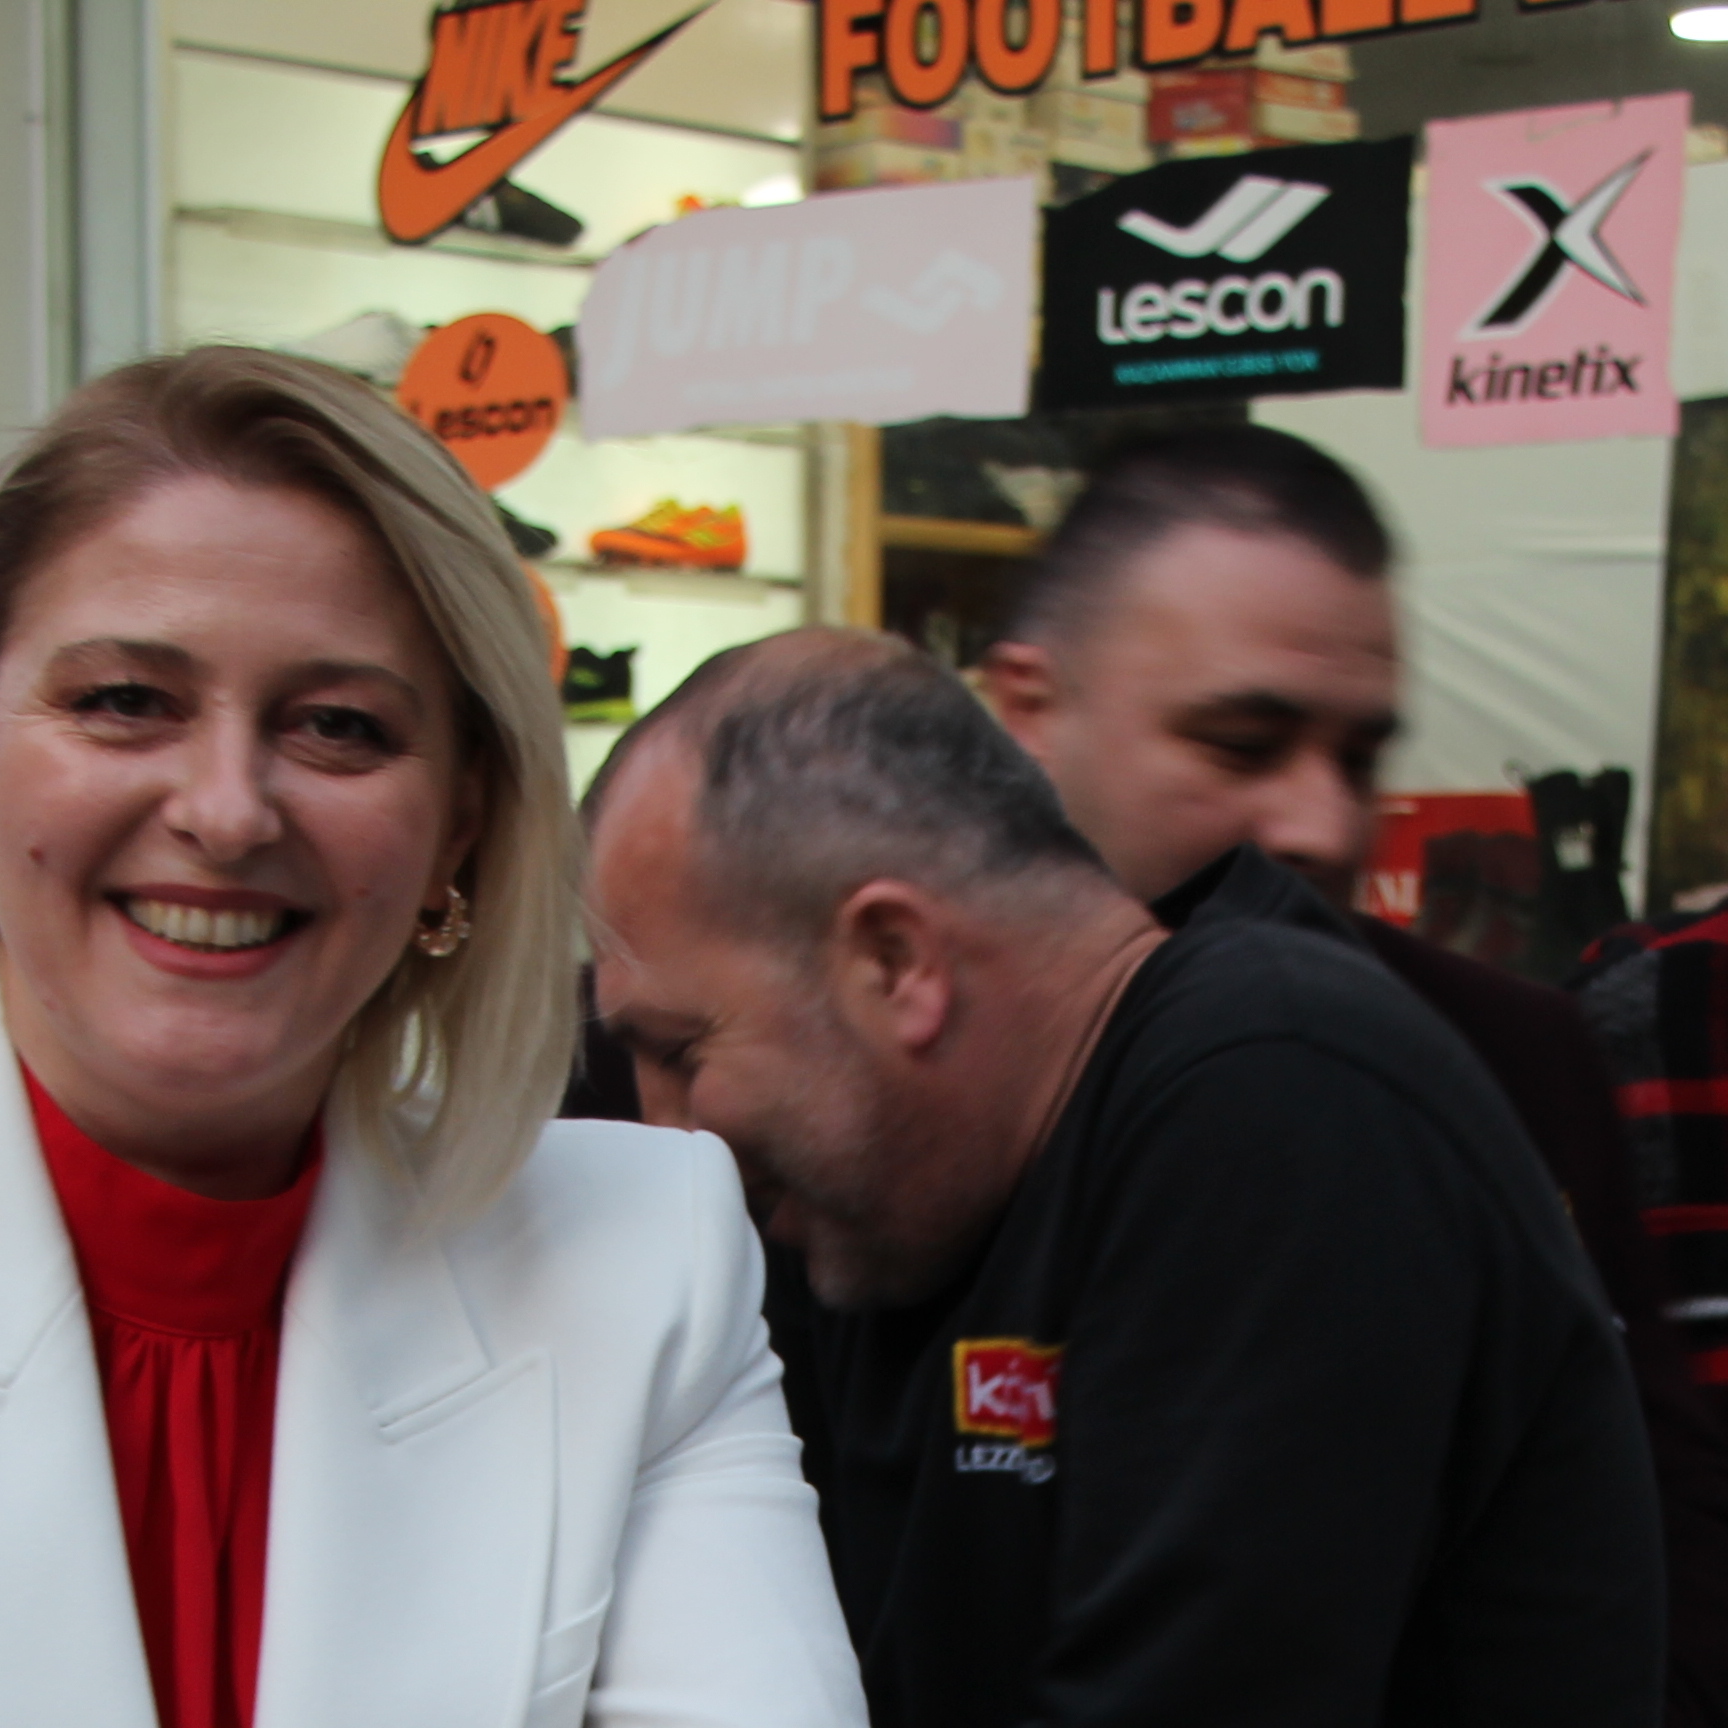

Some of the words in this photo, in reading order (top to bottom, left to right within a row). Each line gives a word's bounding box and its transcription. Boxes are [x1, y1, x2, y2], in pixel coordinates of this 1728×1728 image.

[818, 0, 1478, 121] FOOTB
[600, 236, 857, 392] JUMP
[408, 397, 553, 441] escon
[1445, 345, 1644, 406] kinetix
